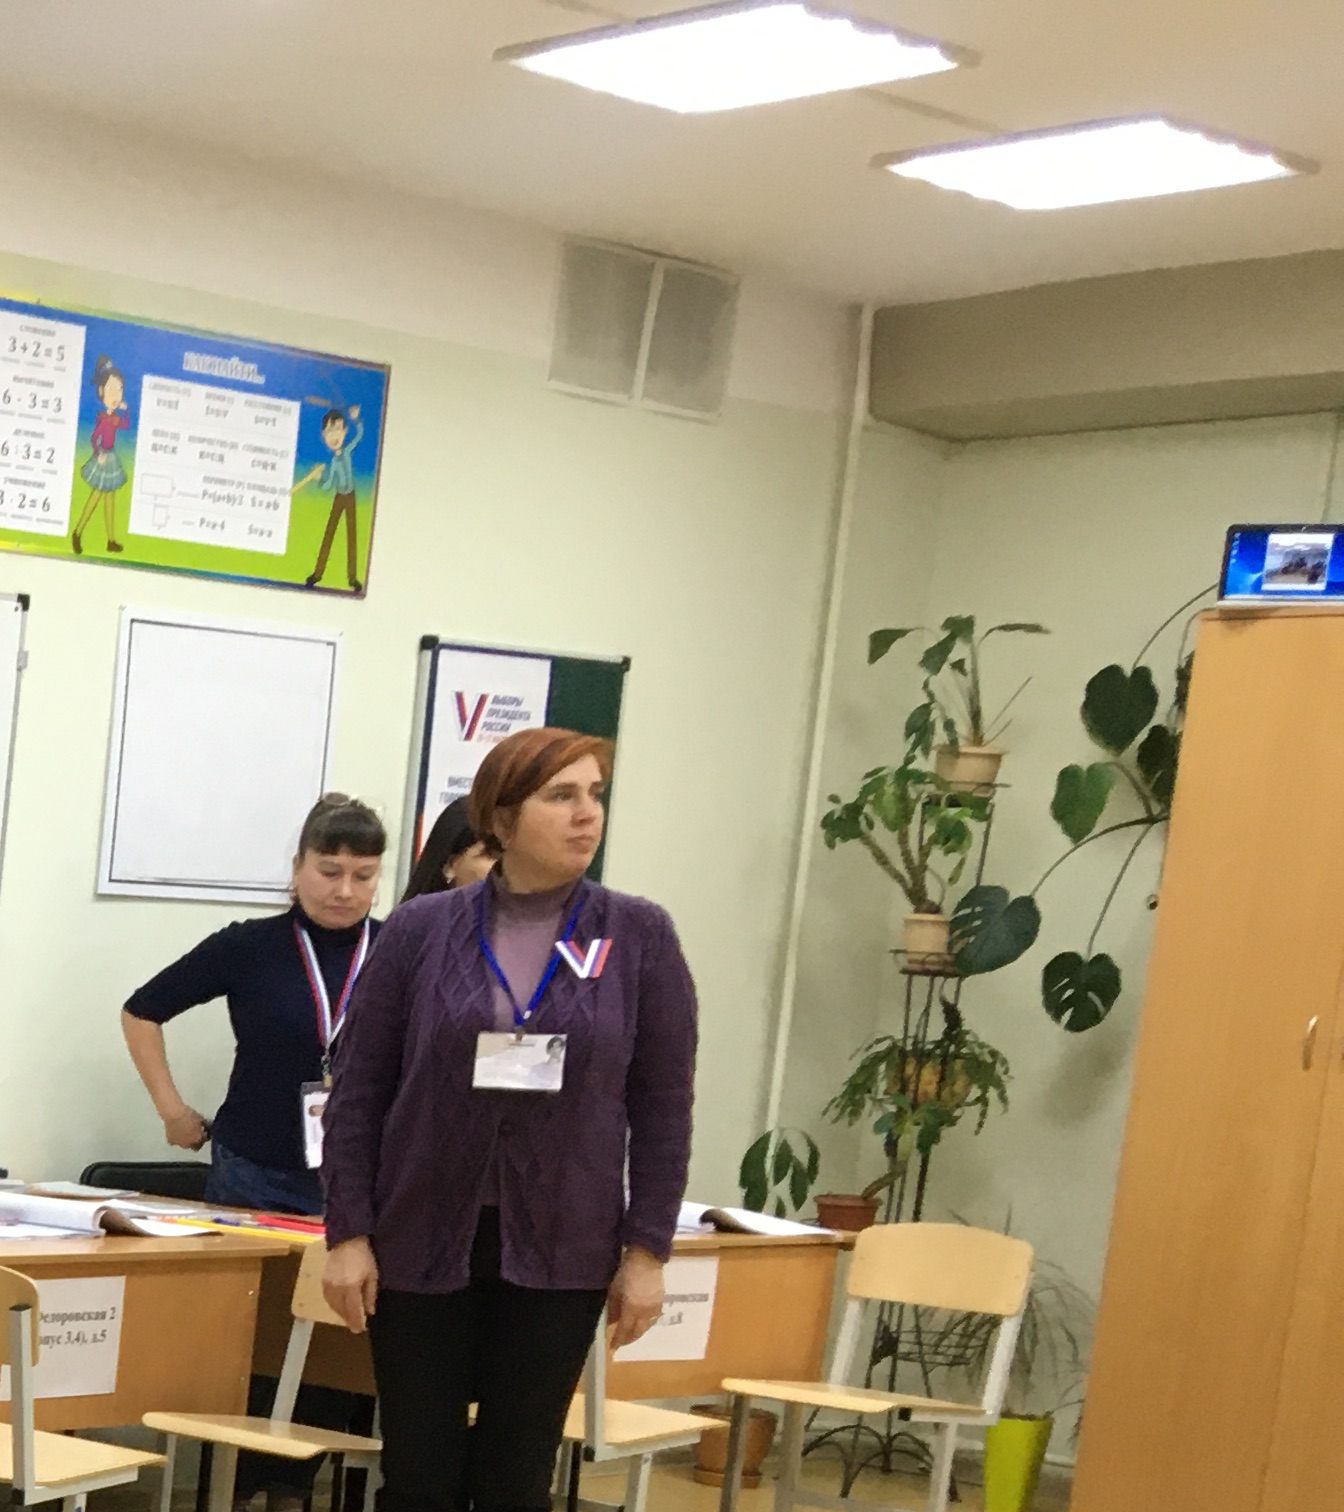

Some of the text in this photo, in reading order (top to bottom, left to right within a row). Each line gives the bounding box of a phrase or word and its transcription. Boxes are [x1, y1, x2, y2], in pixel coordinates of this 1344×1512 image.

[8, 336, 16, 352] 3
[32, 341, 41, 357] 2
[56, 345, 65, 362] 5
[2, 389, 11, 404] 6
[28, 392, 37, 409] 3
[53, 396, 62, 413] 3
[0, 440, 9, 456] 6
[22, 443, 31, 460] 3
[46, 447, 55, 464] 2
[18, 493, 26, 509] 2
[42, 497, 50, 512] 6
[109, 1306, 116, 1320] 2
